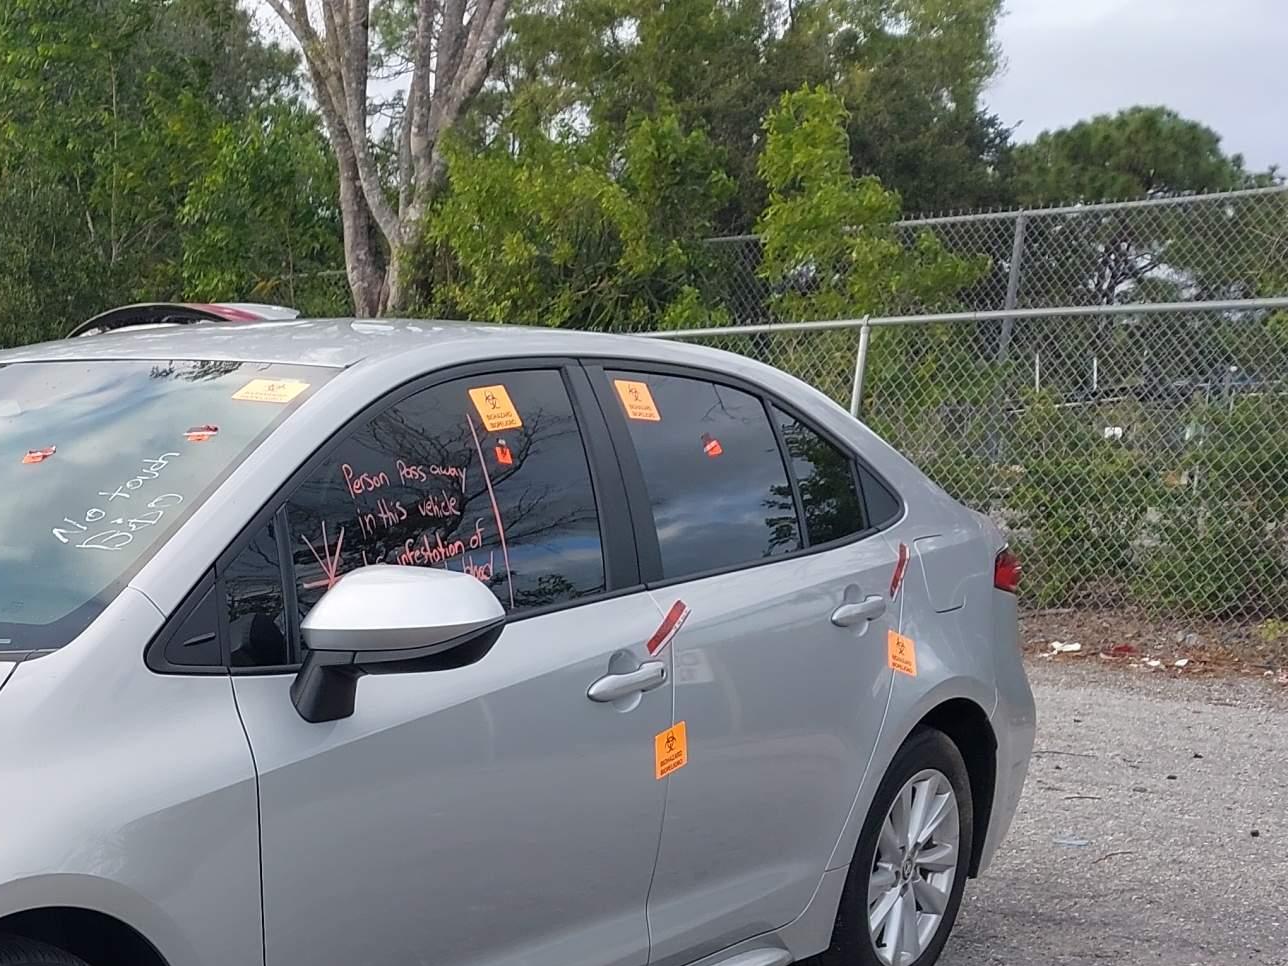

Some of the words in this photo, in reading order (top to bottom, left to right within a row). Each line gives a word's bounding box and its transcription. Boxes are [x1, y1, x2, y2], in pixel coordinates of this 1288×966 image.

[342, 464, 390, 499] Person
[429, 465, 467, 494] away
[52, 507, 106, 544] No
[357, 508, 377, 541] in
[378, 500, 408, 530] this
[418, 492, 462, 518] vehicle
[470, 517, 486, 549] of
